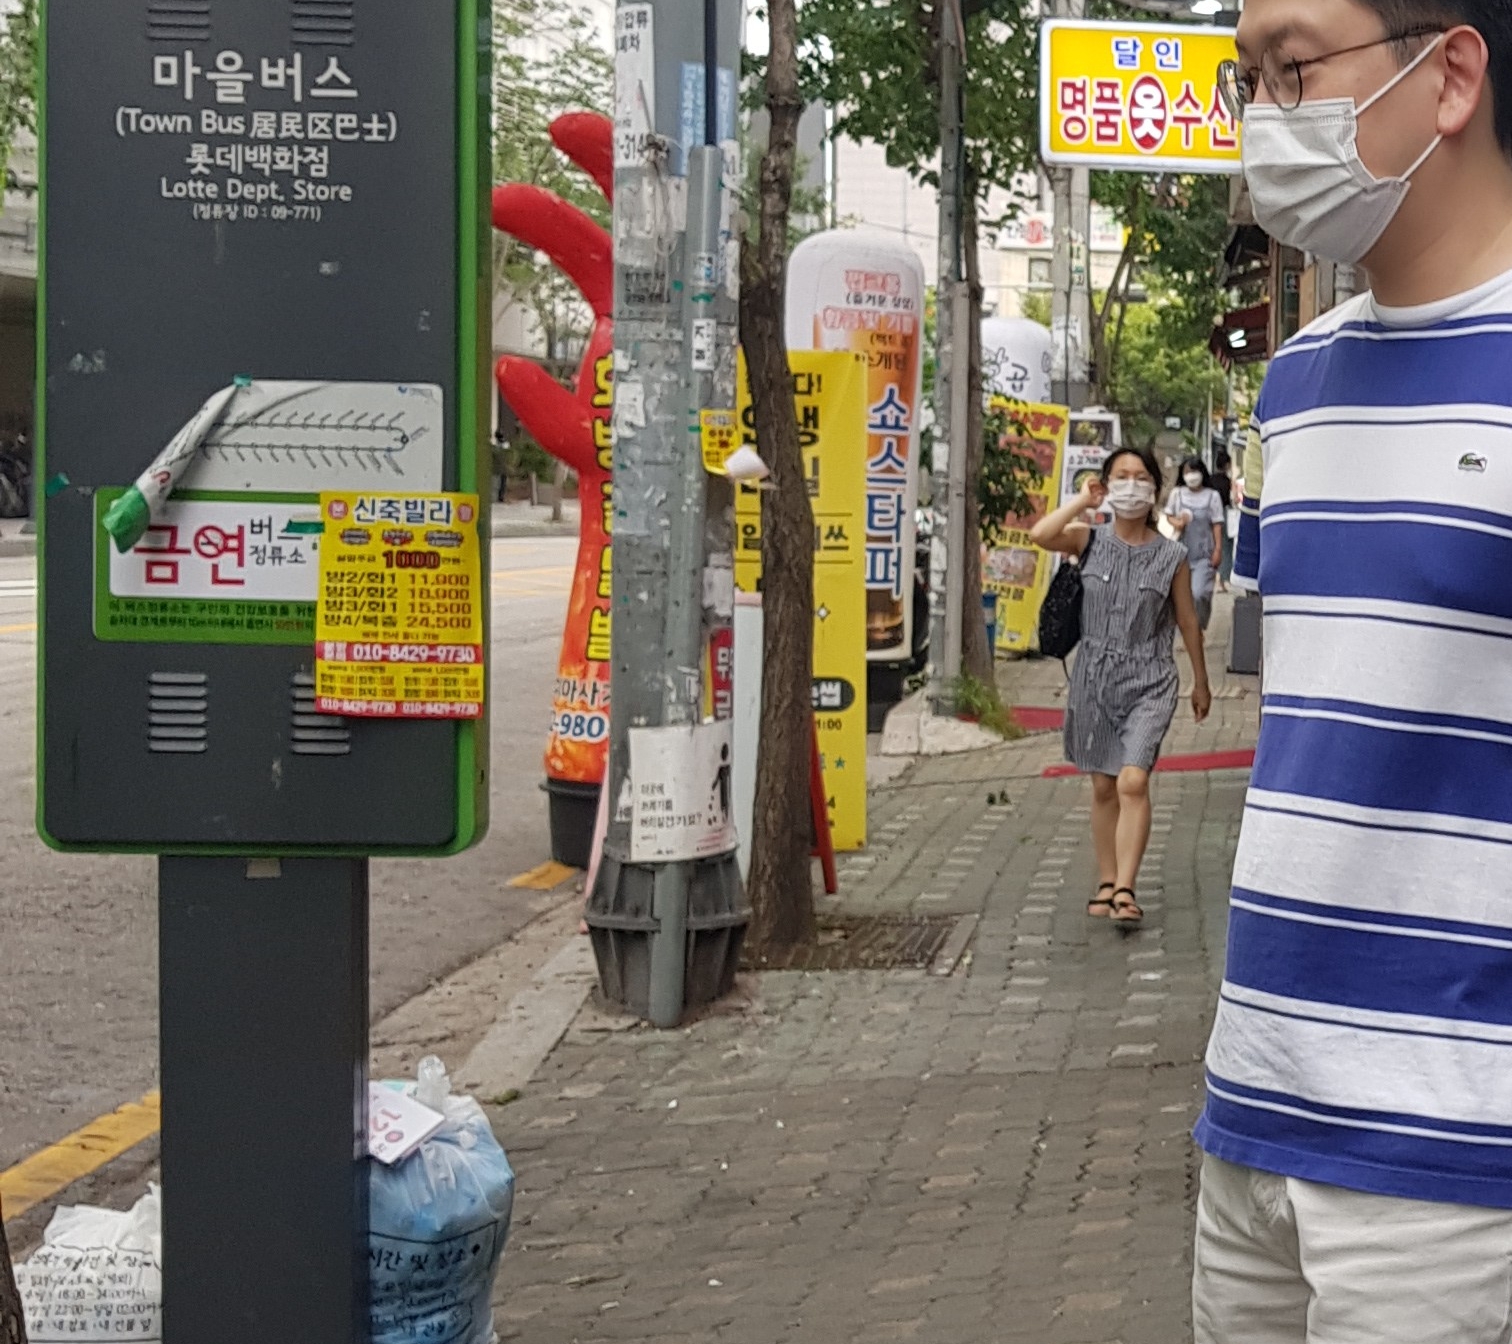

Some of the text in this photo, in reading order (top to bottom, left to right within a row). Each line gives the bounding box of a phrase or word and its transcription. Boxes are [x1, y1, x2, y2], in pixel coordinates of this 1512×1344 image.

[153, 51, 358, 104] 마을버스
[115, 107, 192, 137] (Town
[200, 109, 245, 135] Bus
[186, 143, 329, 177] 롯데백화점
[161, 177, 352, 203] Lotte Dept. Store
[354, 498, 452, 525] 신축빌라
[134, 524, 246, 585] 금연
[250, 544, 307, 567] 정류소
[353, 643, 476, 663] 010-8429-9730
